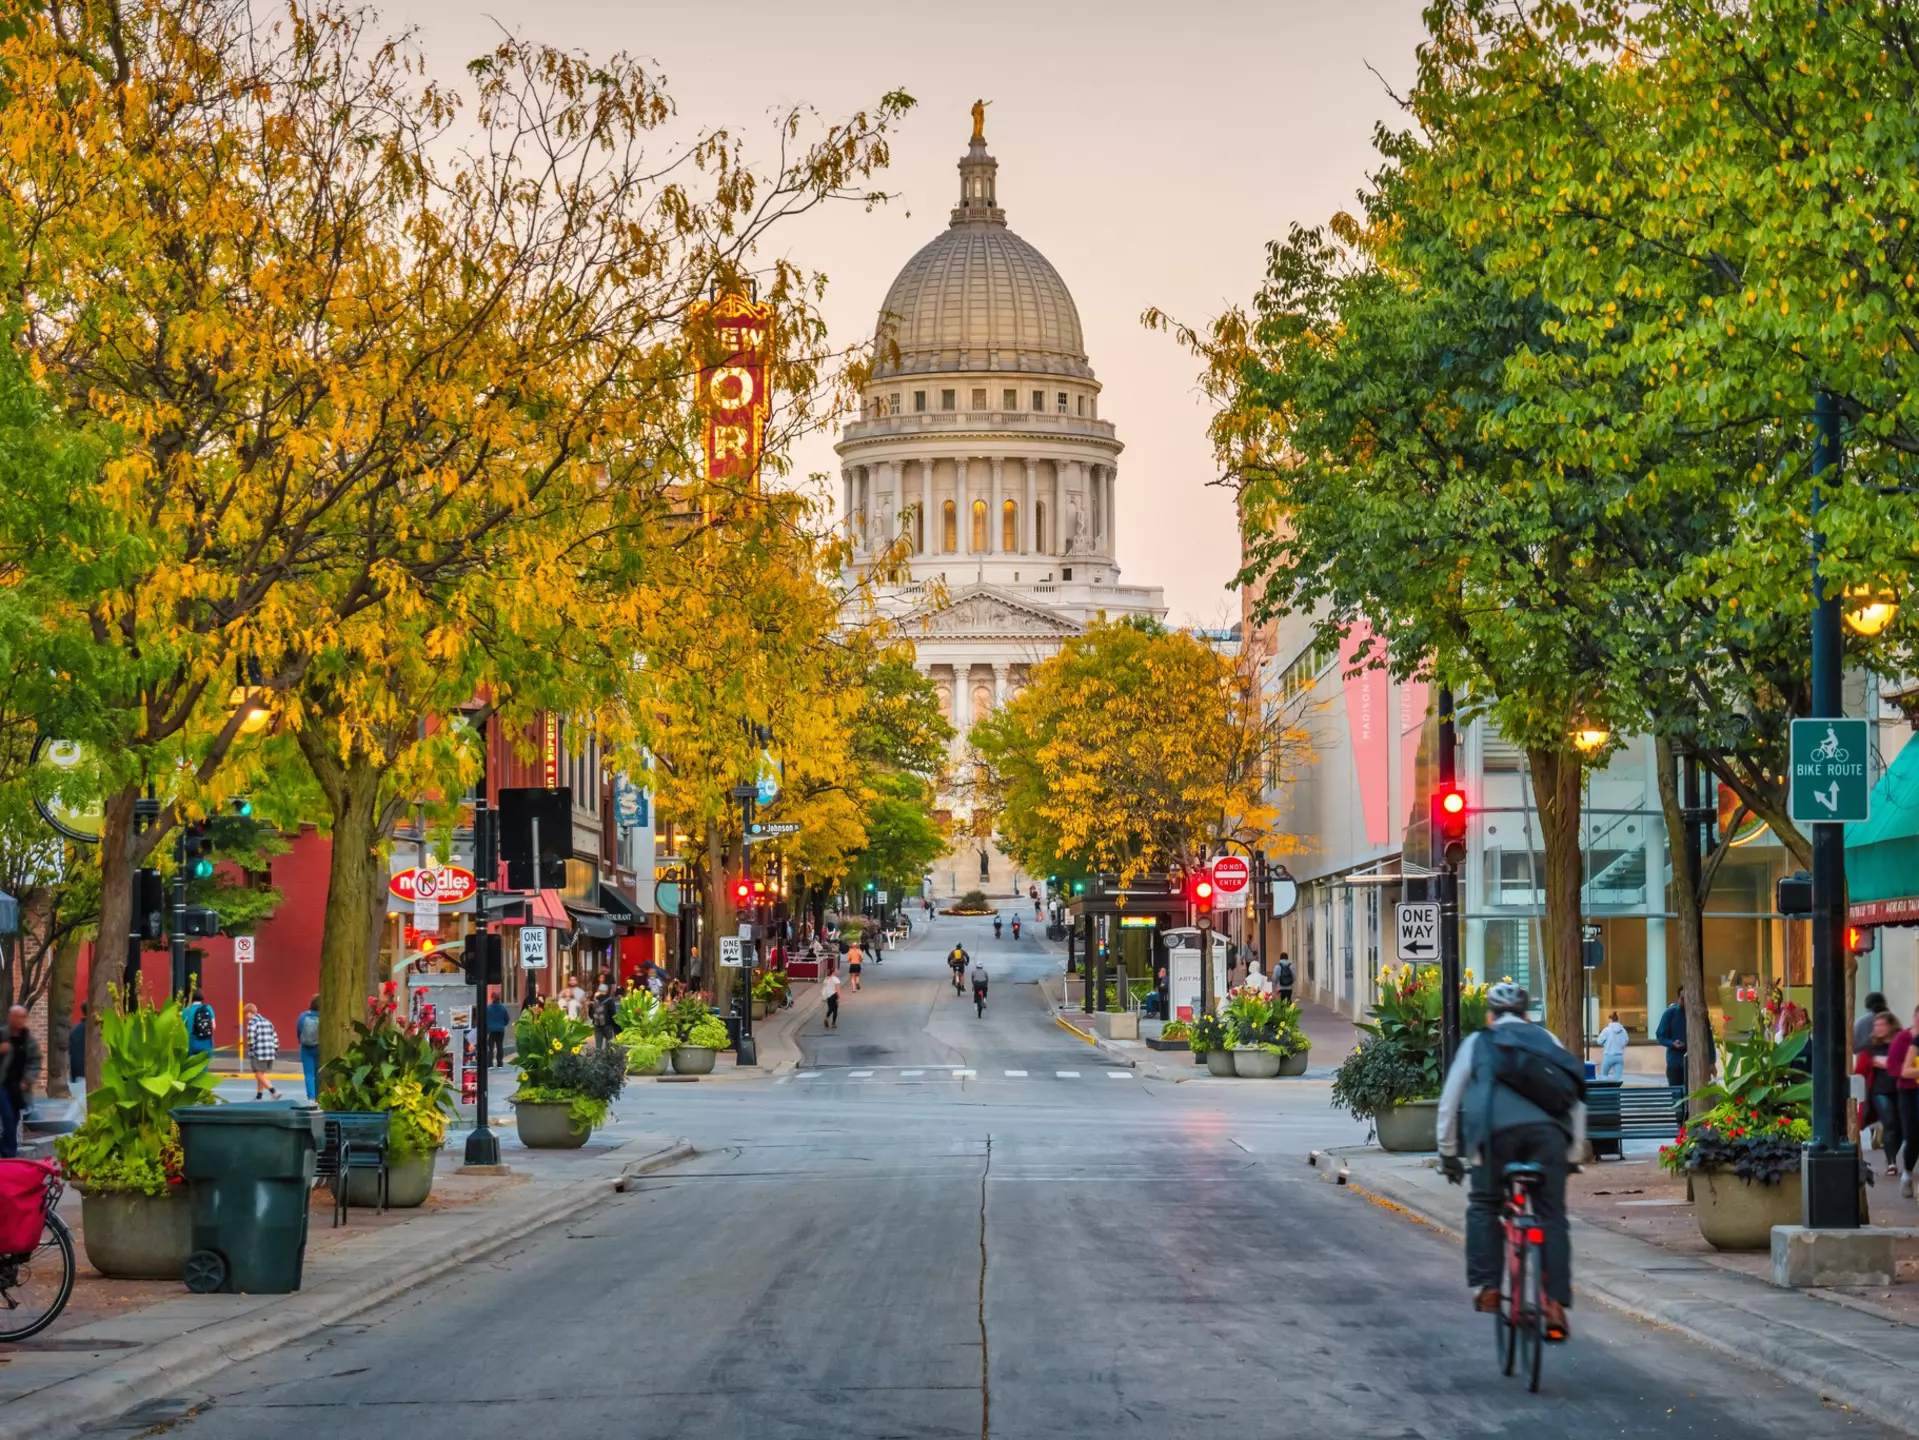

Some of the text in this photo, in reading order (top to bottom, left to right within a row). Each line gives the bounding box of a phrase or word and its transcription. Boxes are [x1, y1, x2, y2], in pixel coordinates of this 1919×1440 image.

[1362, 684, 1370, 739] MADISON
[1797, 764, 1863, 776] BIKE ROUTE
[766, 824, 794, 833] Johnson
[400, 869, 470, 889] ndles
[437, 889, 464, 898] mpany
[1402, 909, 1434, 922] ONE
[524, 931, 542, 942] ONE
[1402, 925, 1434, 938] WAY
[524, 943, 543, 953] WAY
